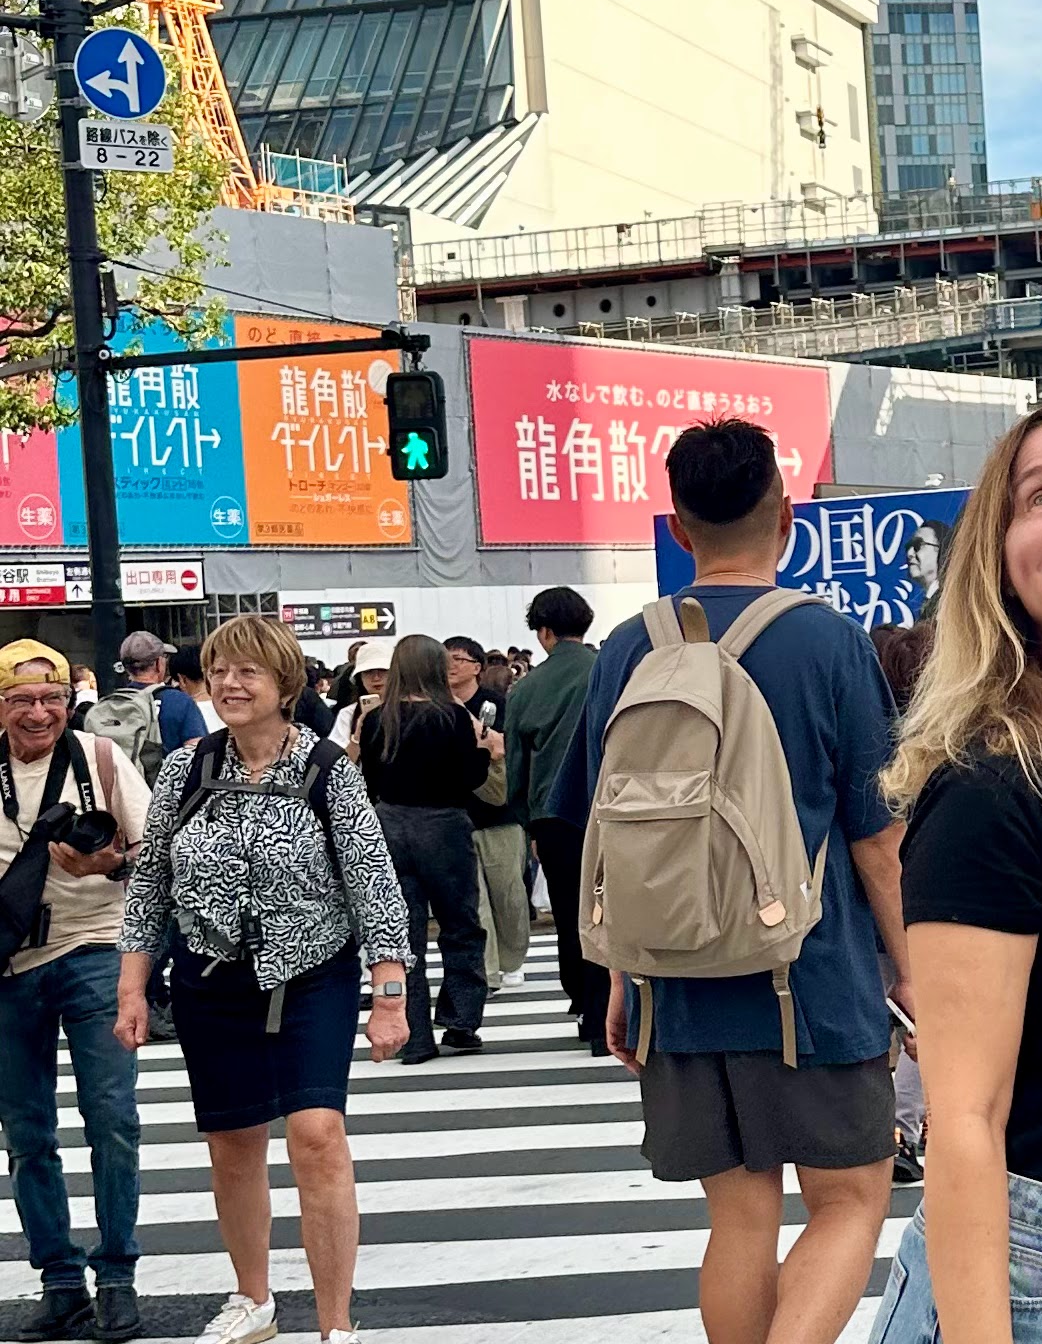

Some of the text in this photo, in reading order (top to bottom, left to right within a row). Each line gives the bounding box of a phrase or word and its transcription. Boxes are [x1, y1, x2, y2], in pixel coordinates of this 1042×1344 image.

[86, 126, 168, 147] 路線バスを除く
[279, 365, 369, 419] 龍角散
[546, 379, 774, 416] 水なしで飲む、のど直接うるおう
[271, 422, 386, 473] ダイレクト
[20, 507, 53, 526] 生薬
[213, 508, 242, 526] 生薬
[379, 510, 404, 527] 生薬
[0, 568, 30, 584] 谷駅
[126, 569, 177, 586] 出口専用
[0, 762, 12, 800] LUMIX
